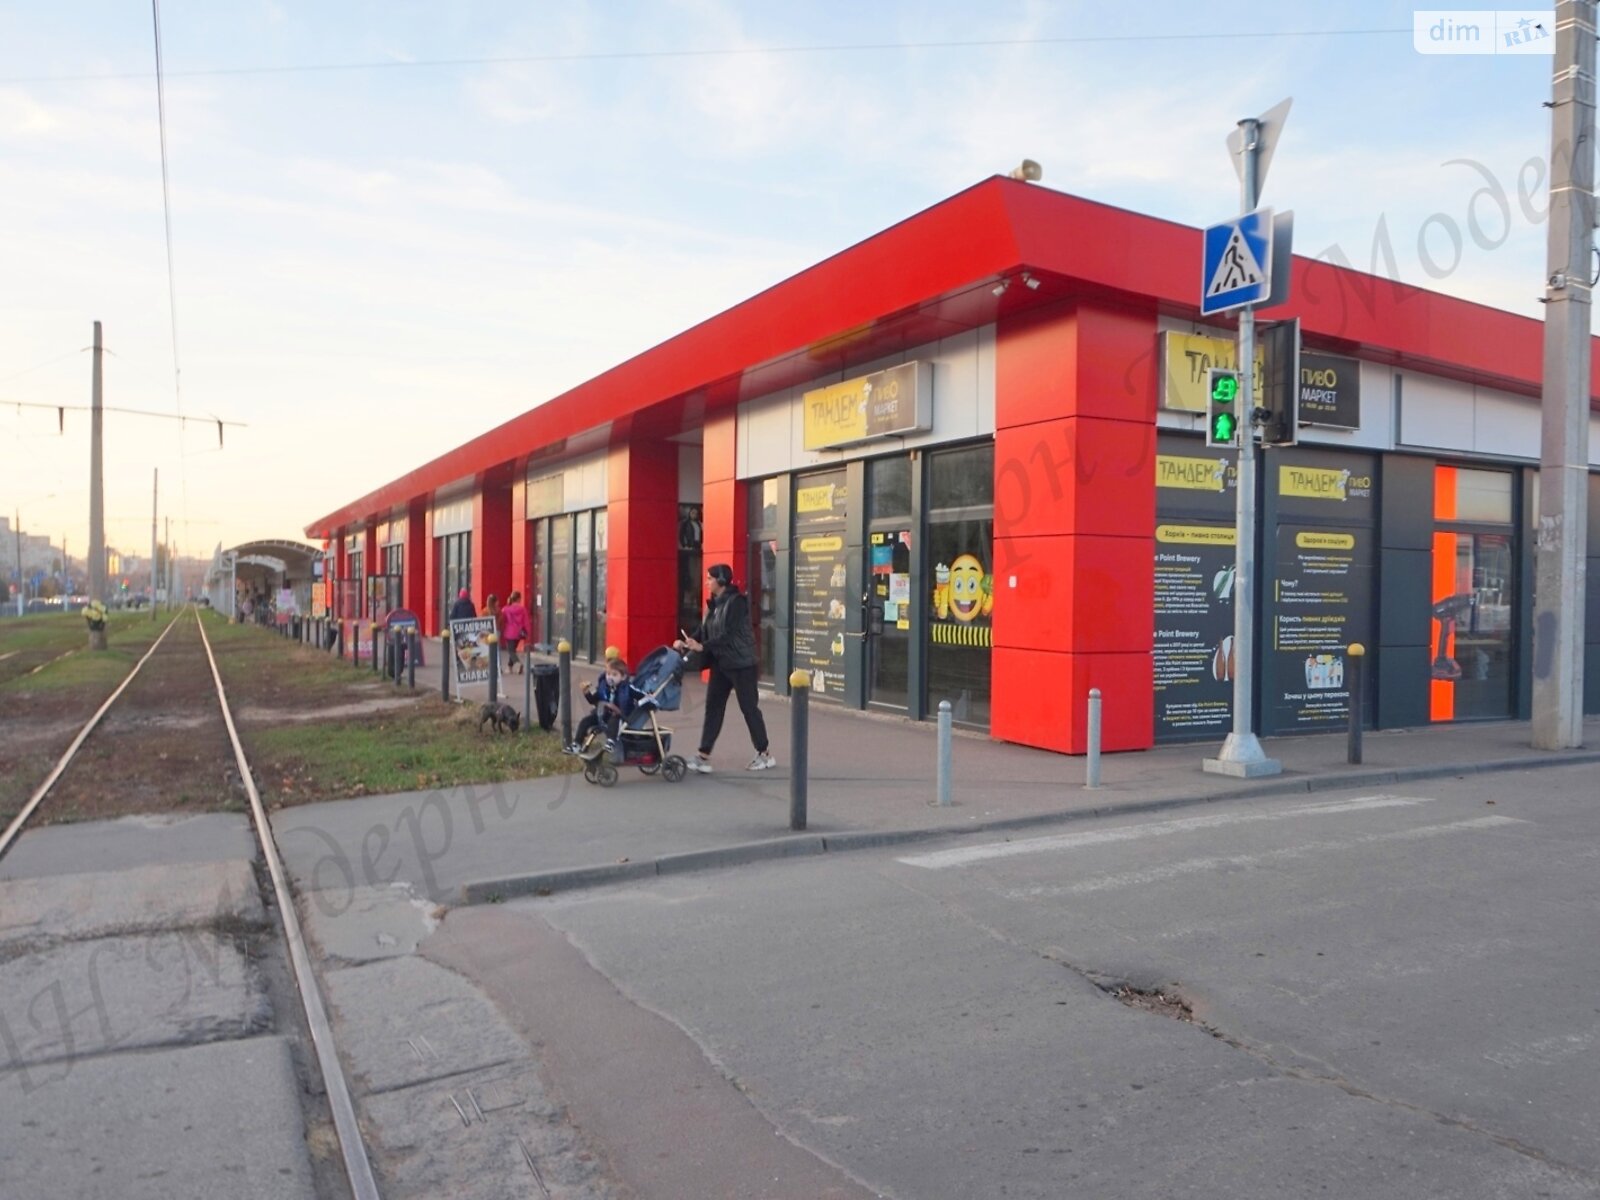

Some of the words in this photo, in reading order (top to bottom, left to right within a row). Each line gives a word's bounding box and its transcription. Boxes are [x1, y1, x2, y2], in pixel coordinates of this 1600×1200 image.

[1301, 368, 1337, 388] ПИВО
[1301, 387, 1337, 404] МАРКЕТ
[811, 393, 859, 426] ТАНДЕМ
[1159, 461, 1215, 485] ТАНДЕМ
[1289, 471, 1338, 493] ТАНДЕМ
[1177, 554, 1201, 564] Brewery
[454, 620, 492, 634] SHAURMA
[1175, 630, 1200, 639] Brewery
[460, 670, 489, 681] KHARK
